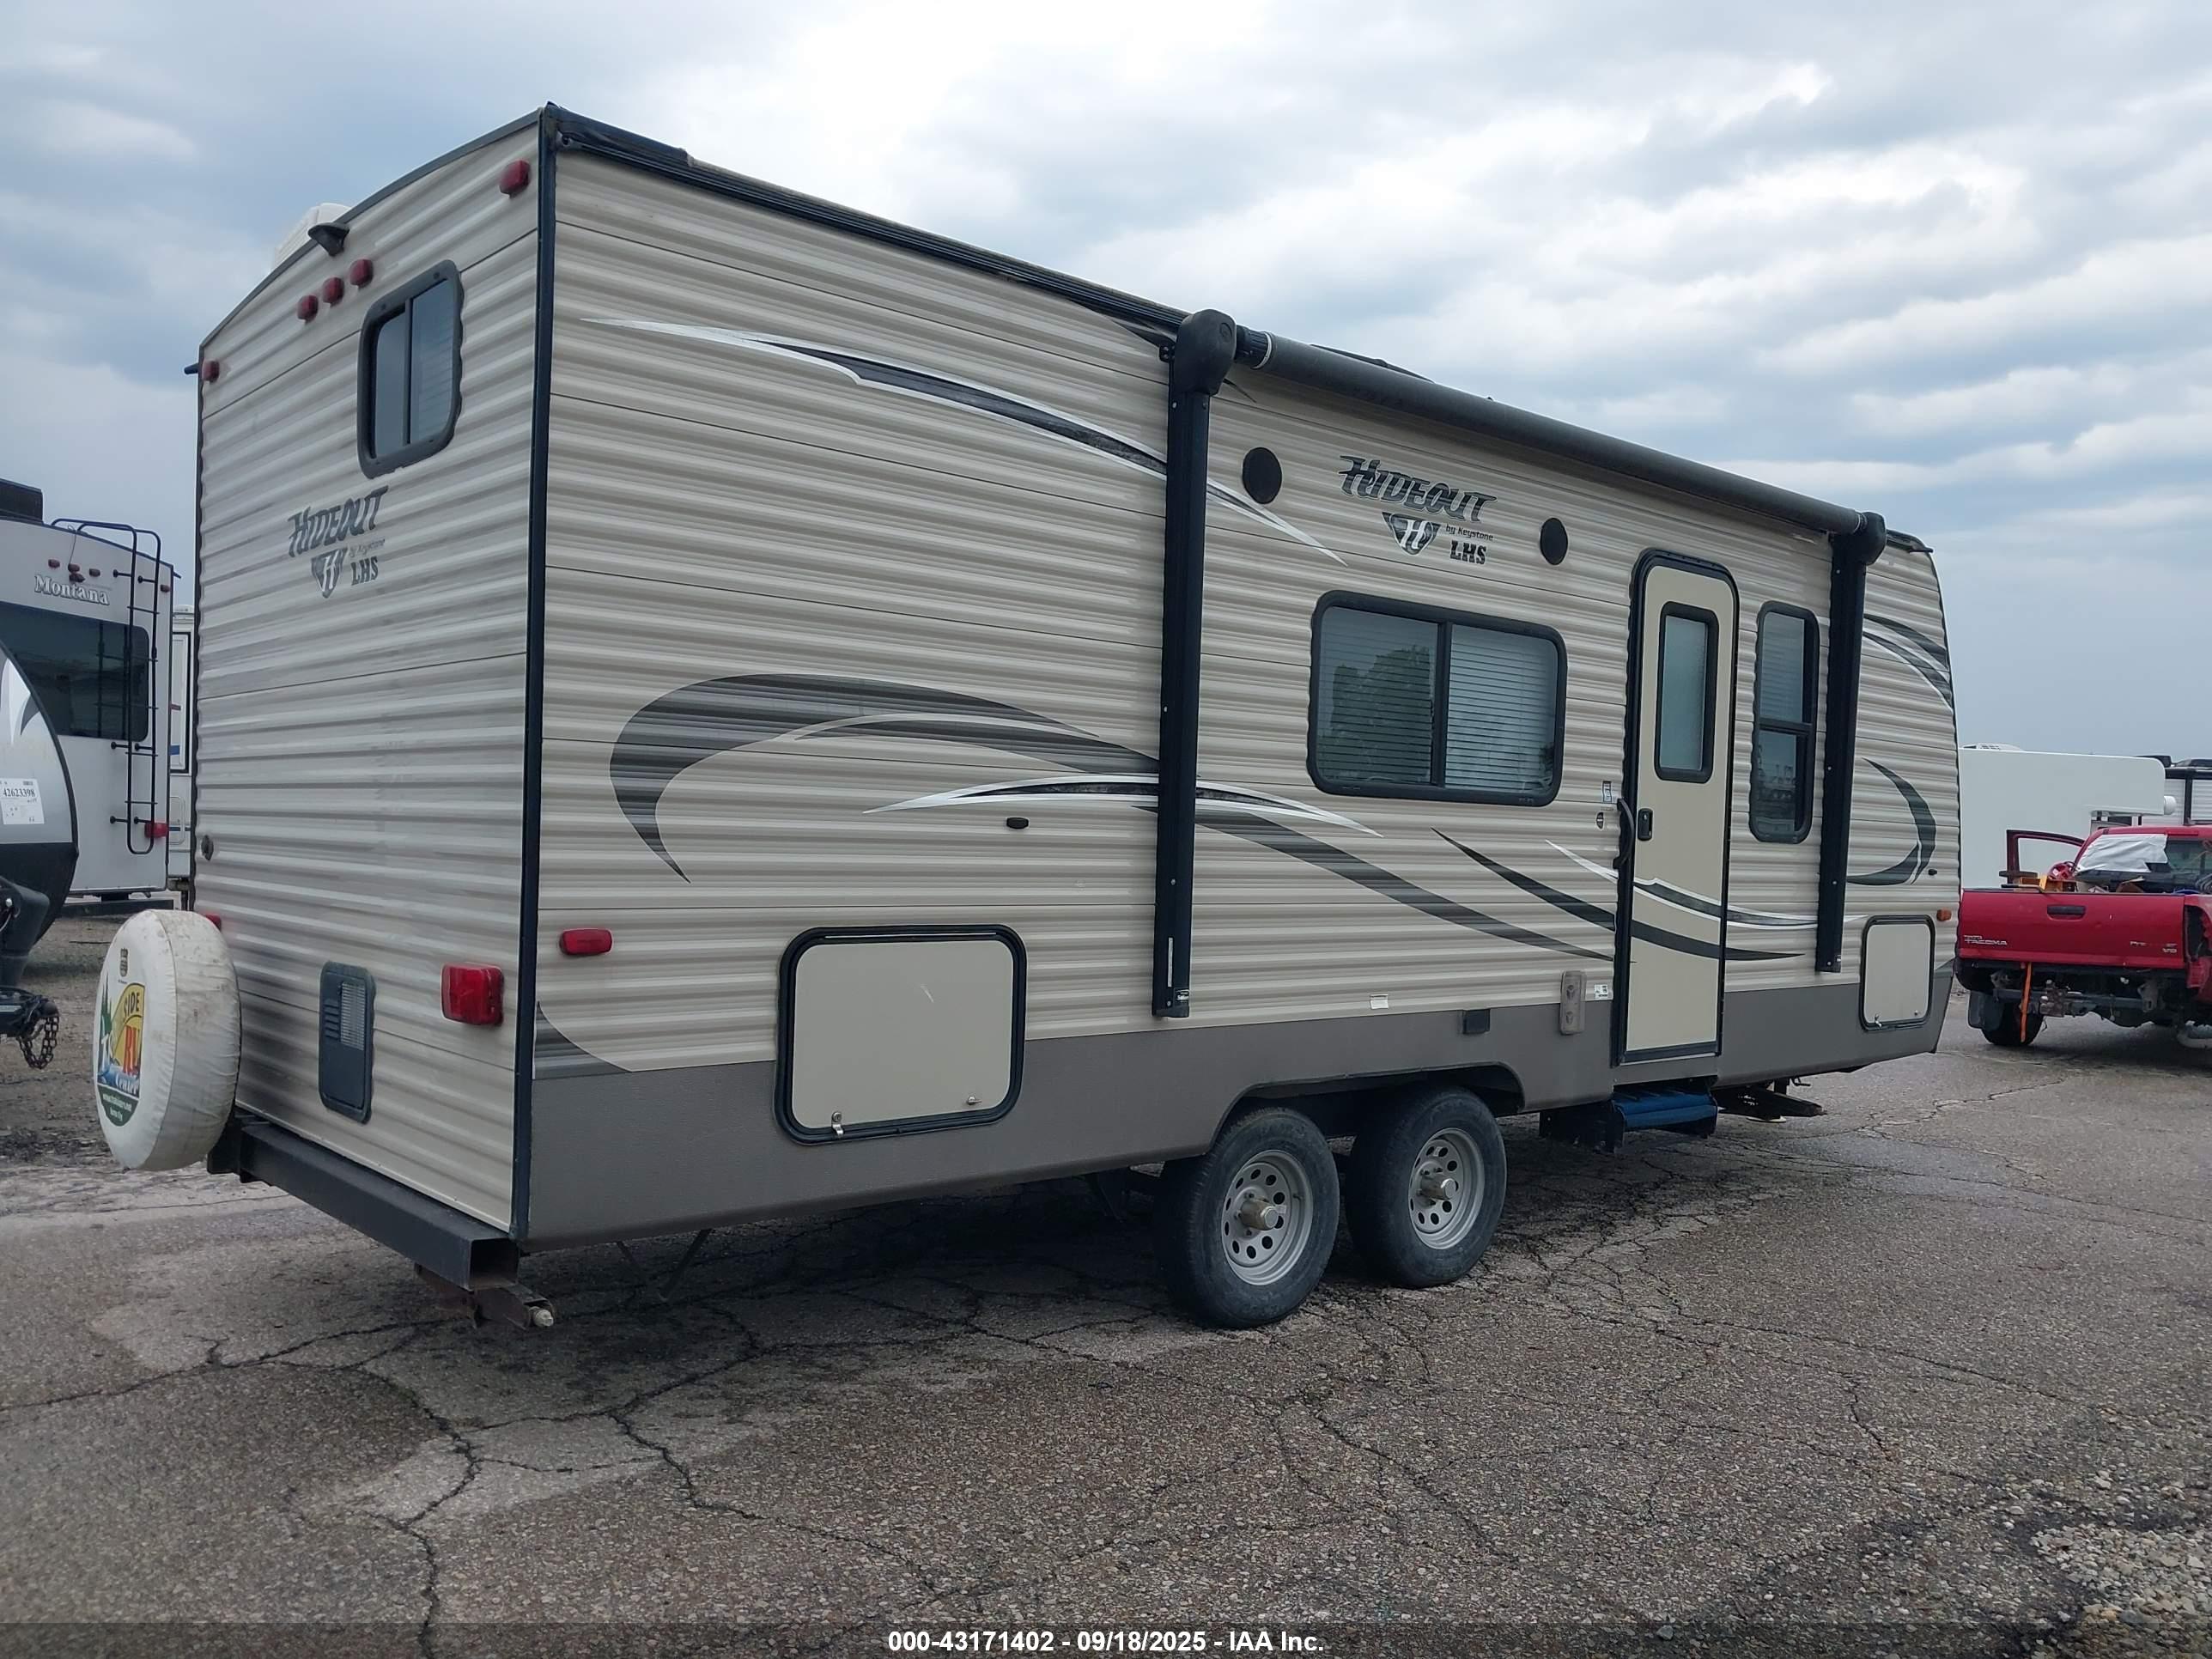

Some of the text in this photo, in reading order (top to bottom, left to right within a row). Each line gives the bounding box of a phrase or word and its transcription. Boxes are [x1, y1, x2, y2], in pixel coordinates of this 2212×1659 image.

[1338, 455, 1498, 522] HIDEOUT
[288, 485, 390, 558] HIDEOUT
[1446, 524, 1494, 541] by Keystone
[1449, 539, 1487, 565] LHS
[350, 556, 379, 586] LHS
[34, 574, 110, 605] Montana
[3, 787, 35, 798] 42623398
